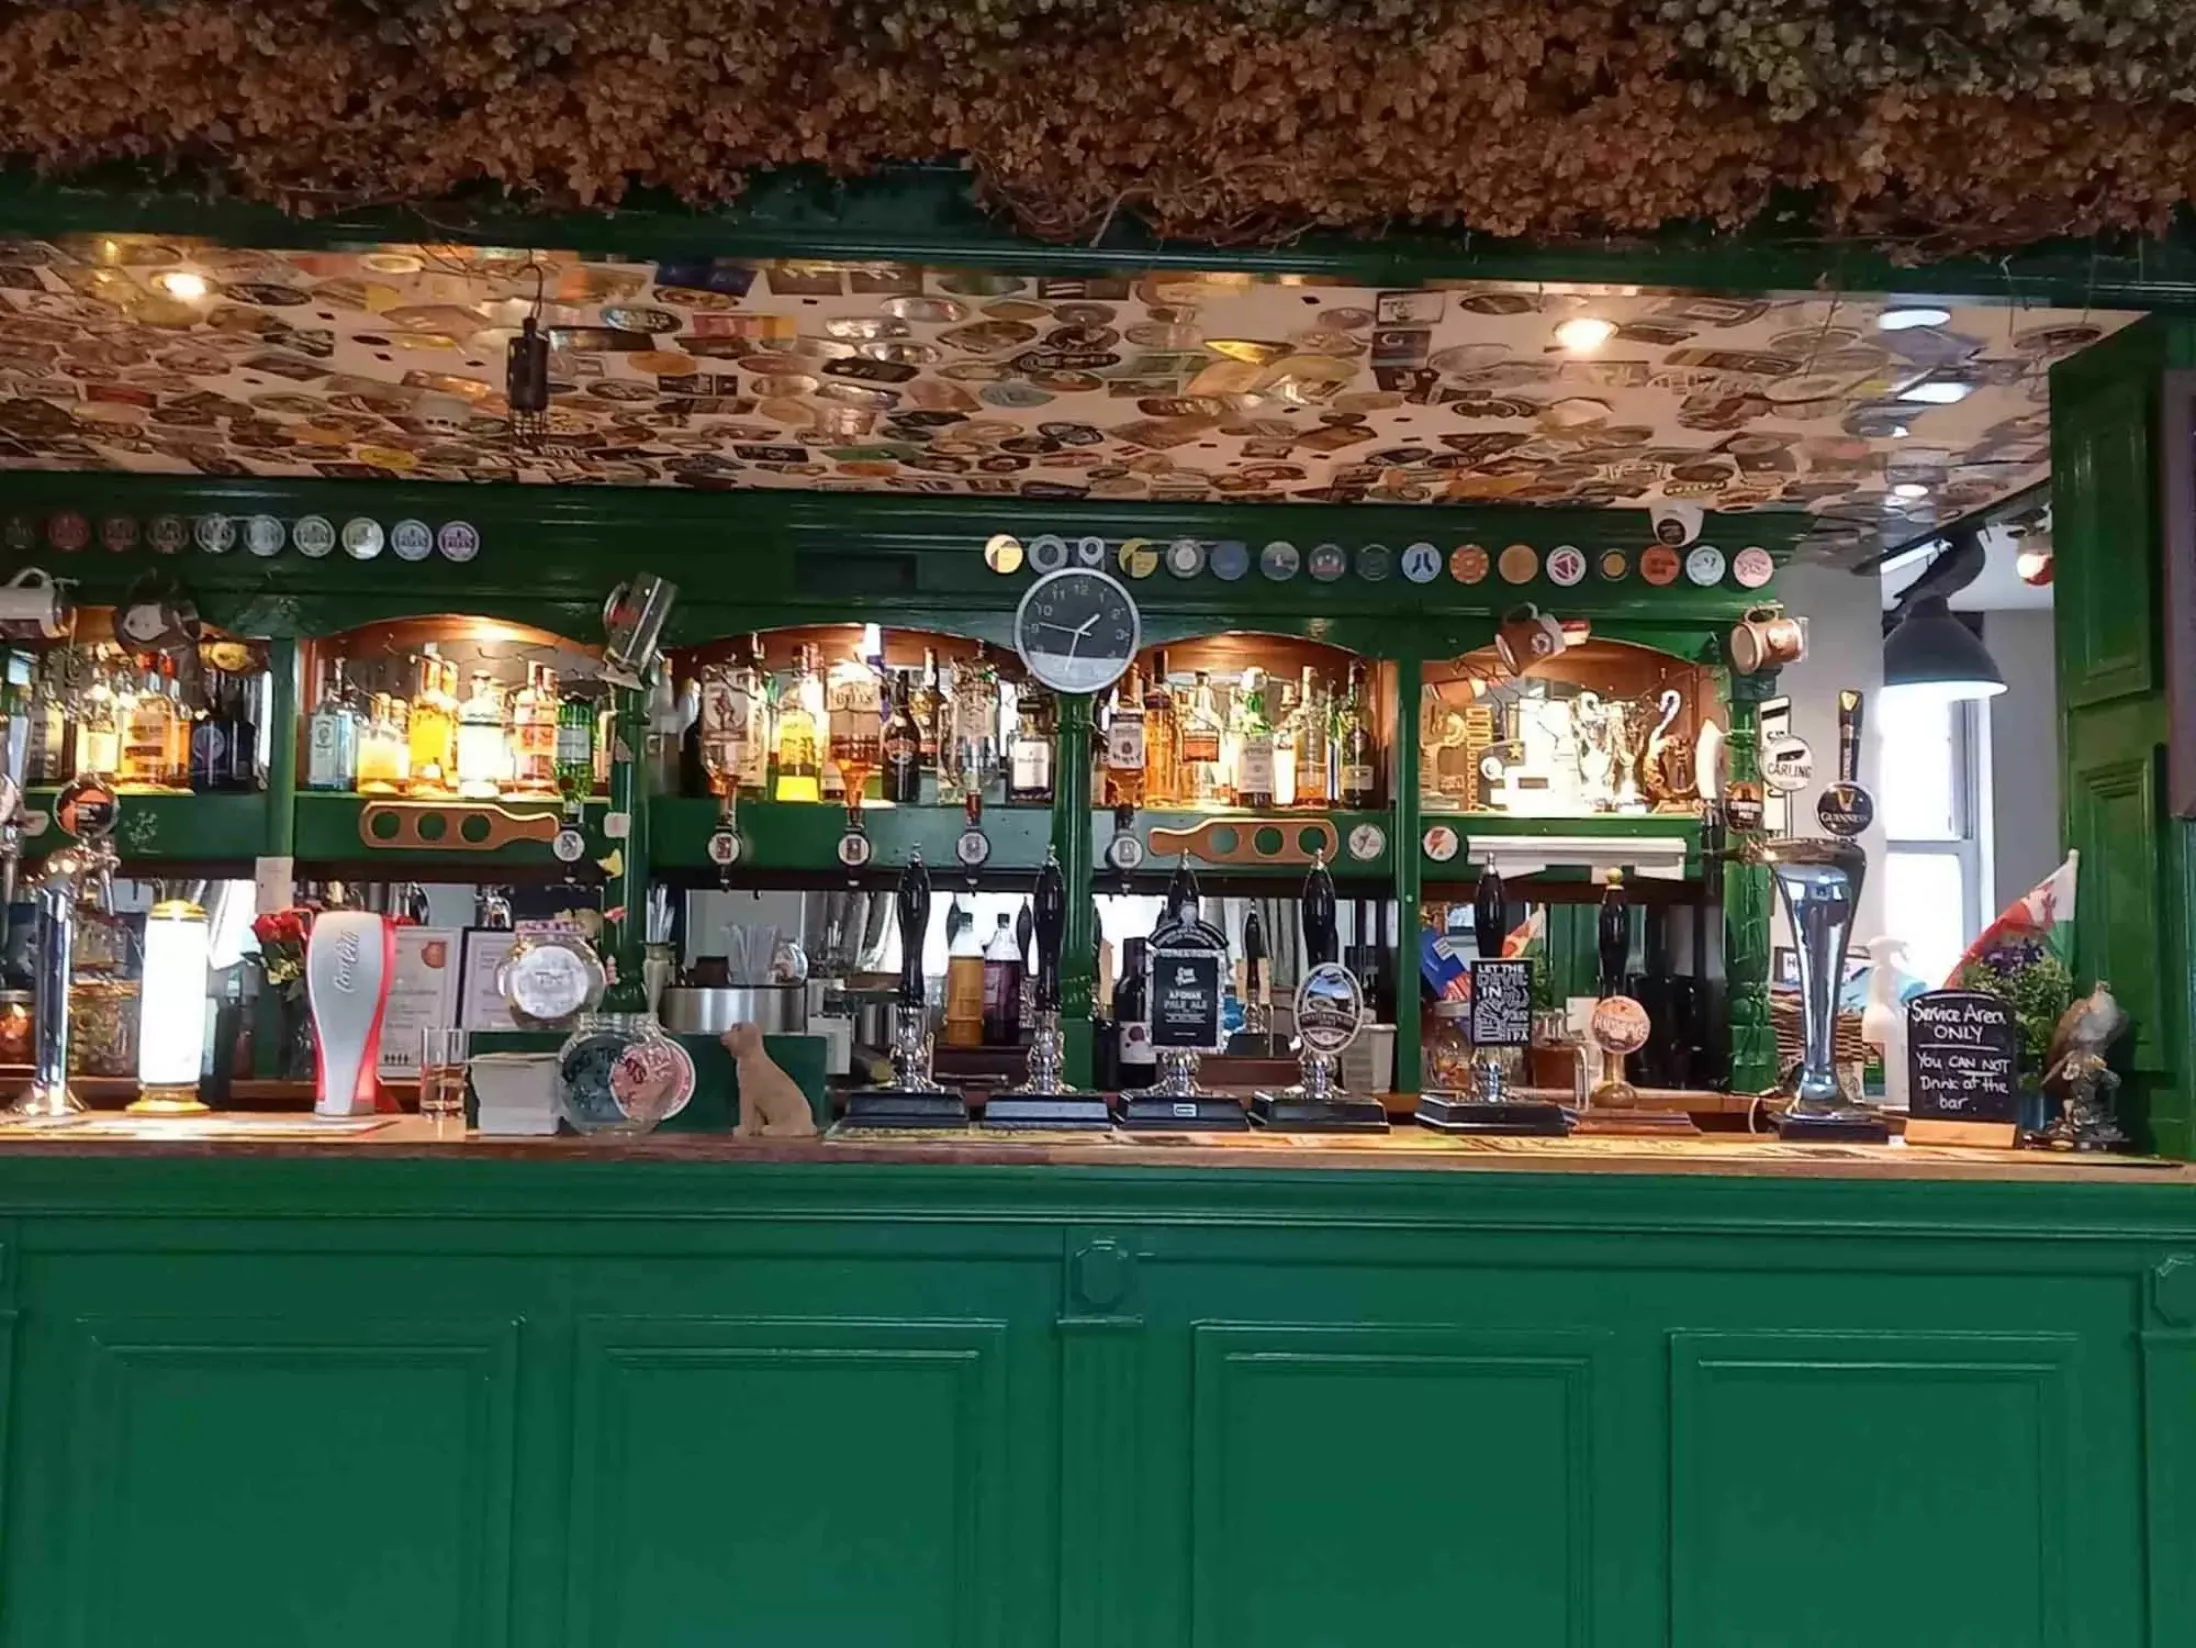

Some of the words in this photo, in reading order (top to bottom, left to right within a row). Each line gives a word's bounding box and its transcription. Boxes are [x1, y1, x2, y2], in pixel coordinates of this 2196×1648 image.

[1052, 588, 1066, 600] 11
[1073, 584, 1090, 596] 12
[1034, 601, 1053, 616] 10
[1111, 607, 1121, 620] 2
[1115, 628, 1125, 640] 3
[1766, 762, 1813, 778] CARLING
[1820, 812, 1869, 825] GUINNESS
[1477, 964, 1498, 974] LET
[1501, 964, 1525, 974] THE
[1482, 986, 1502, 998] IN
[1164, 1000, 1185, 1010] PALE
[1190, 1000, 1208, 1010] ALE
[1911, 999, 1961, 1022] Service
[1963, 1003, 2007, 1025] Area
[1934, 1024, 1984, 1044] ONLY
[1916, 1051, 1942, 1069] You
[1948, 1055, 1976, 1068] CAN
[1981, 1058, 2011, 1074] NOT
[1920, 1075, 1960, 1090] Drink
[1962, 1074, 1981, 1090] at
[1981, 1076, 2009, 1094] the
